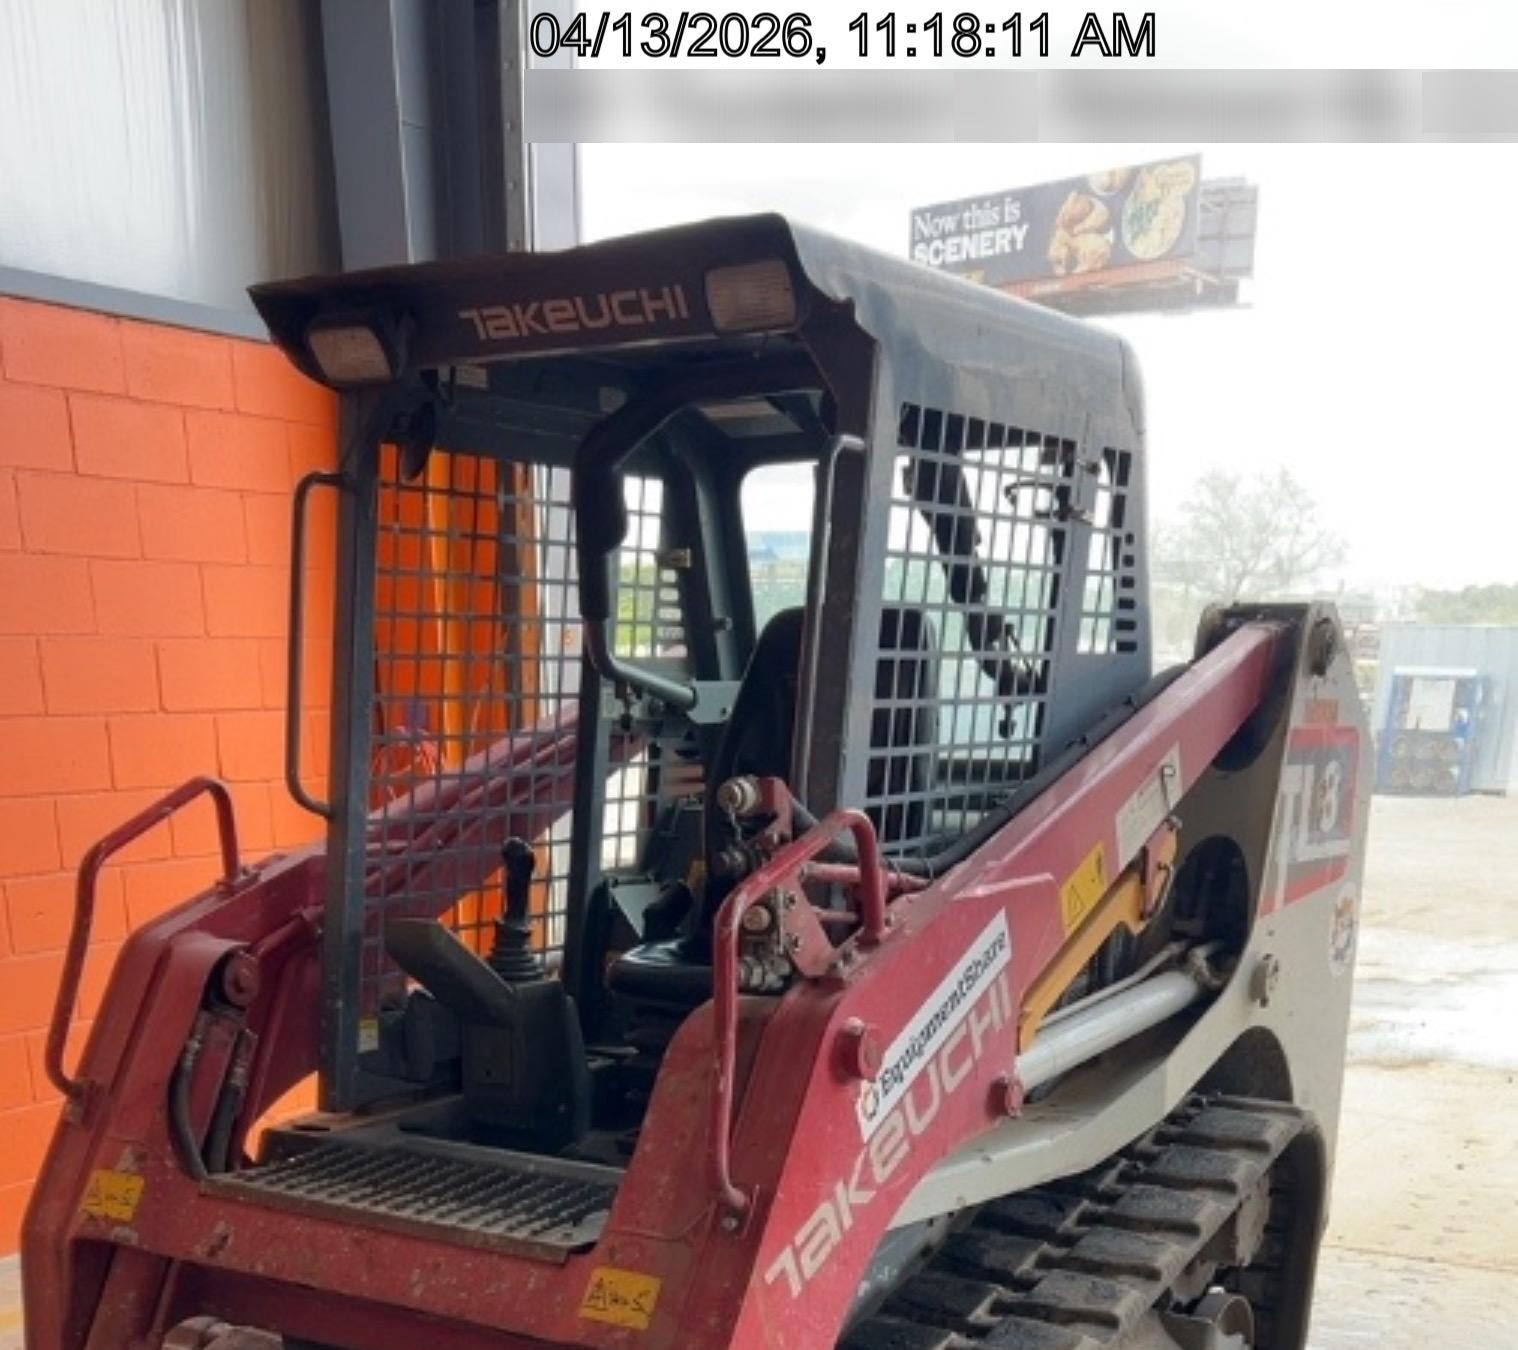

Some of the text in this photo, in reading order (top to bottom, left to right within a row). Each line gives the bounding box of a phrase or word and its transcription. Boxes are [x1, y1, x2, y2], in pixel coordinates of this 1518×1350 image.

[914, 197, 1021, 241] Now this is
[914, 221, 1029, 265] SCENERY
[879, 932, 1005, 1096] EquipmentShare
